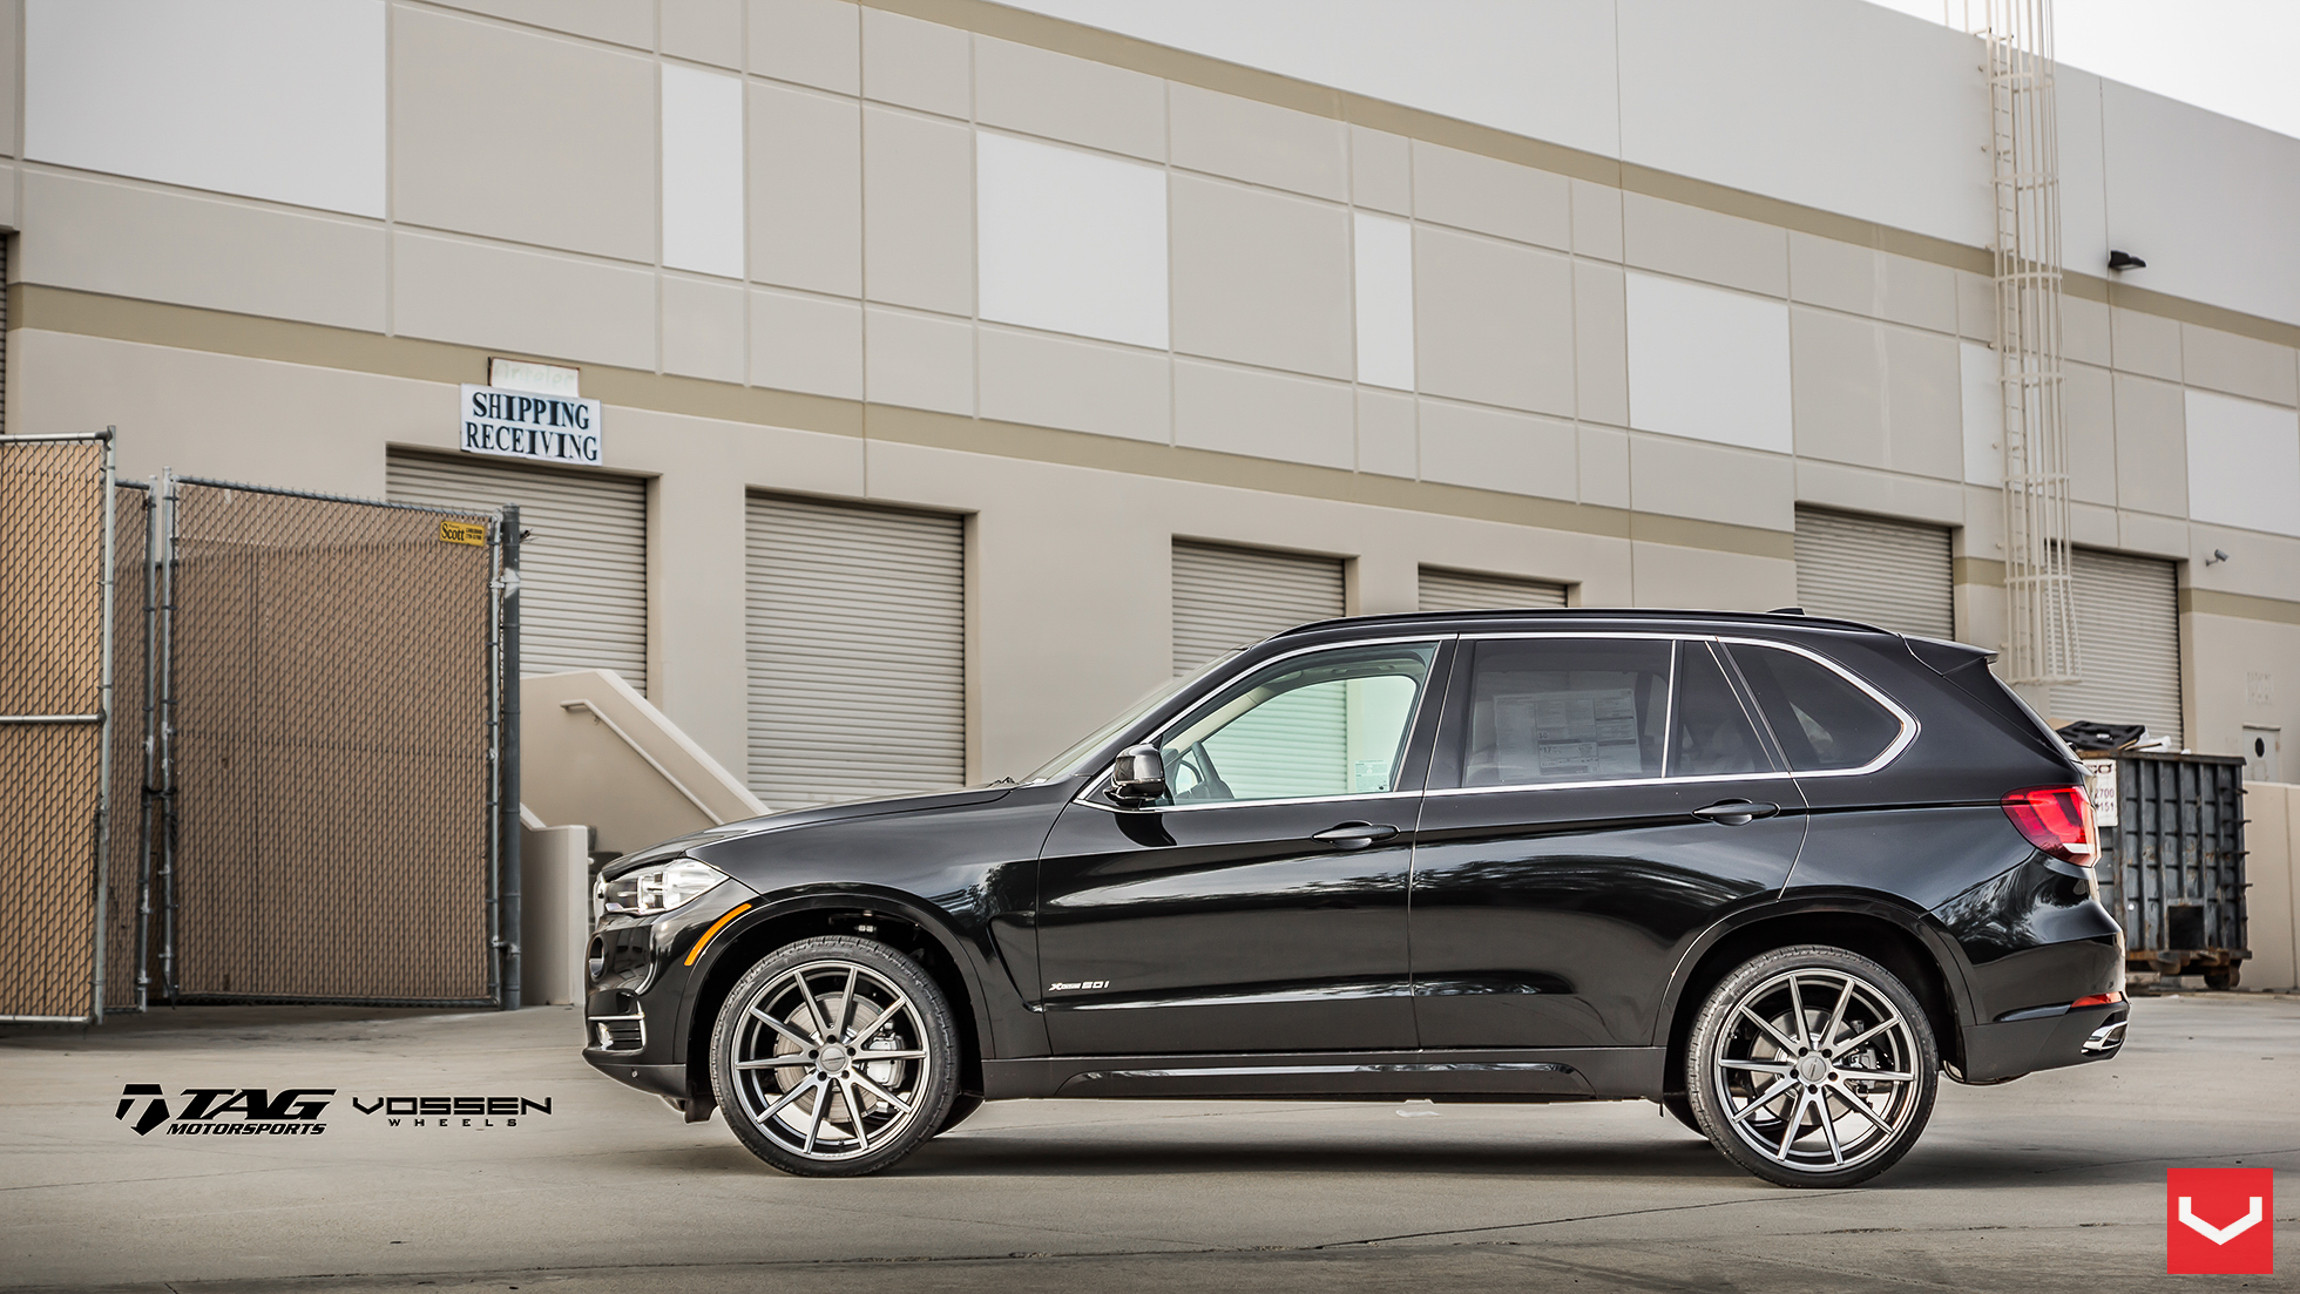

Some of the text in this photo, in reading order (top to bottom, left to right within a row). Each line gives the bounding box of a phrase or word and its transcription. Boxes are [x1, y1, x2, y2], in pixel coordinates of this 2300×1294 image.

[472, 391, 589, 430] SHIPPING
[465, 421, 598, 461] RECEIVING
[441, 522, 465, 541] Scott
